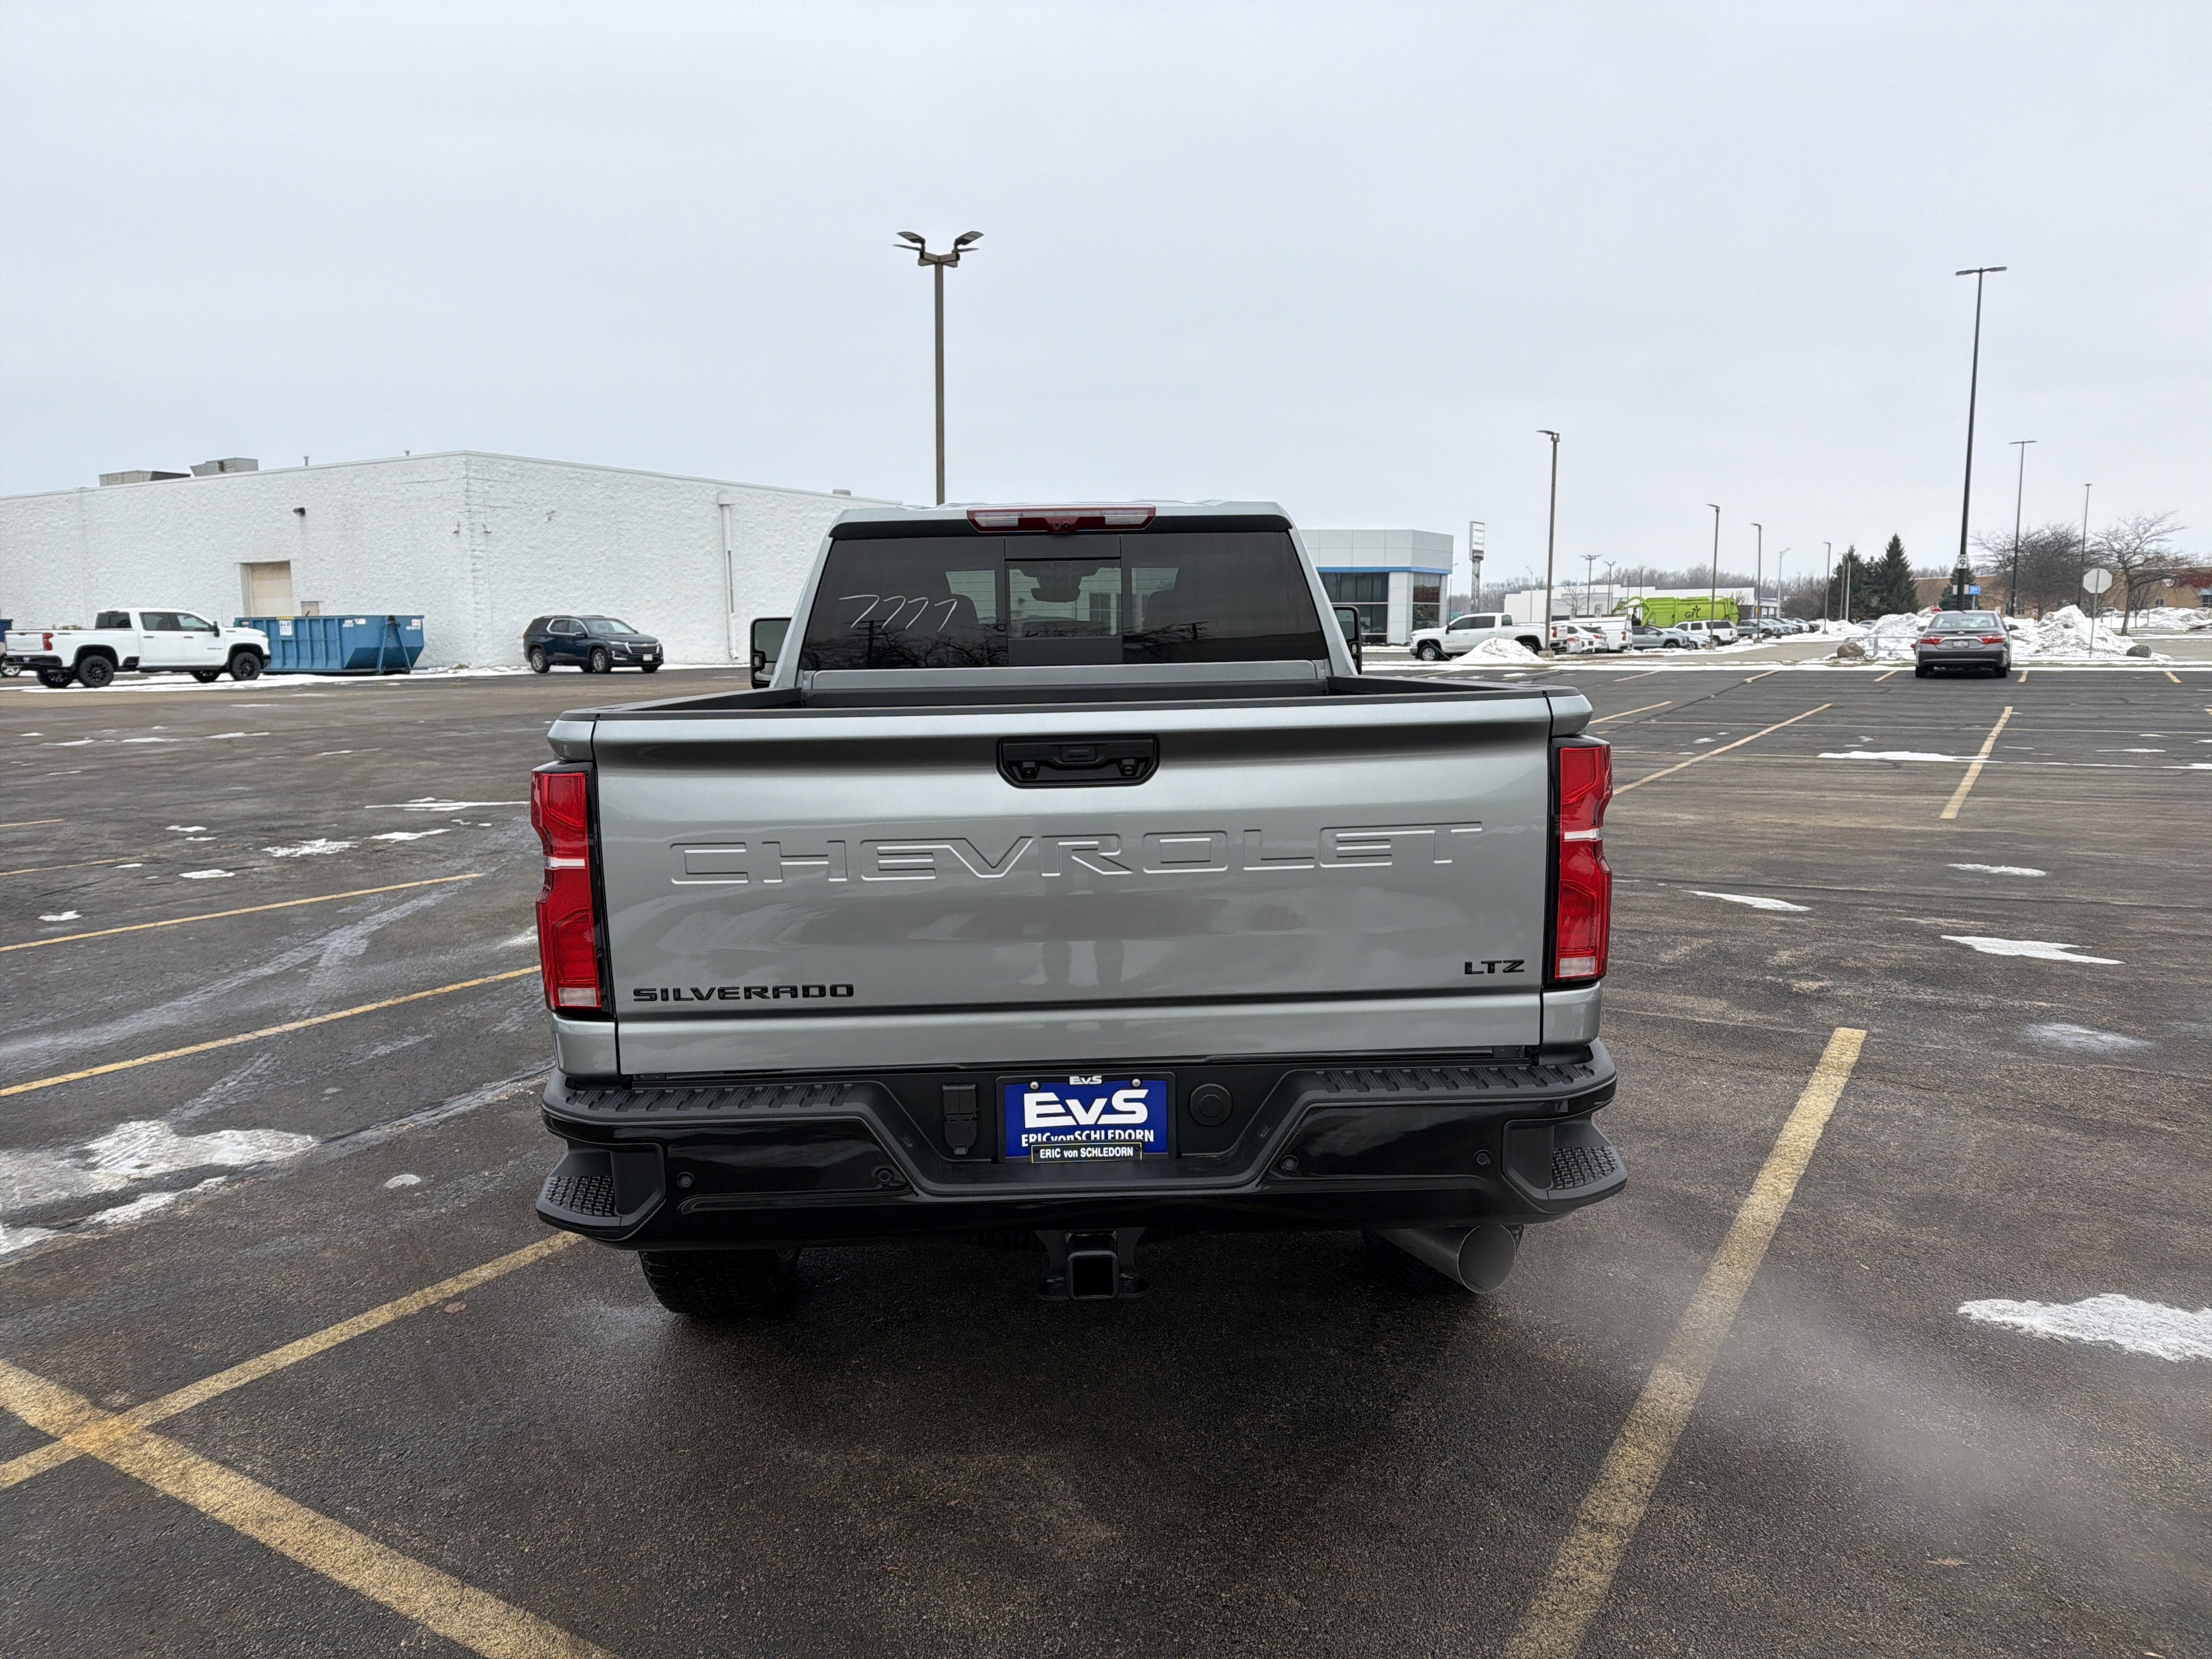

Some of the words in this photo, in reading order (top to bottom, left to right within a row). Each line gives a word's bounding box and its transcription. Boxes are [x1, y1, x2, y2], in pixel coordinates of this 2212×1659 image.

[1960, 559, 1966, 567] 9
[839, 594, 957, 632] 7777
[1684, 607, 1701, 618] GFL
[669, 821, 1482, 884] CHEVROLET
[1464, 959, 1525, 974] LTZ
[633, 984, 854, 1002] SILVERADO
[1040, 1148, 1061, 1159] ERIC
[1080, 1147, 1134, 1158] SCHLEDORN
